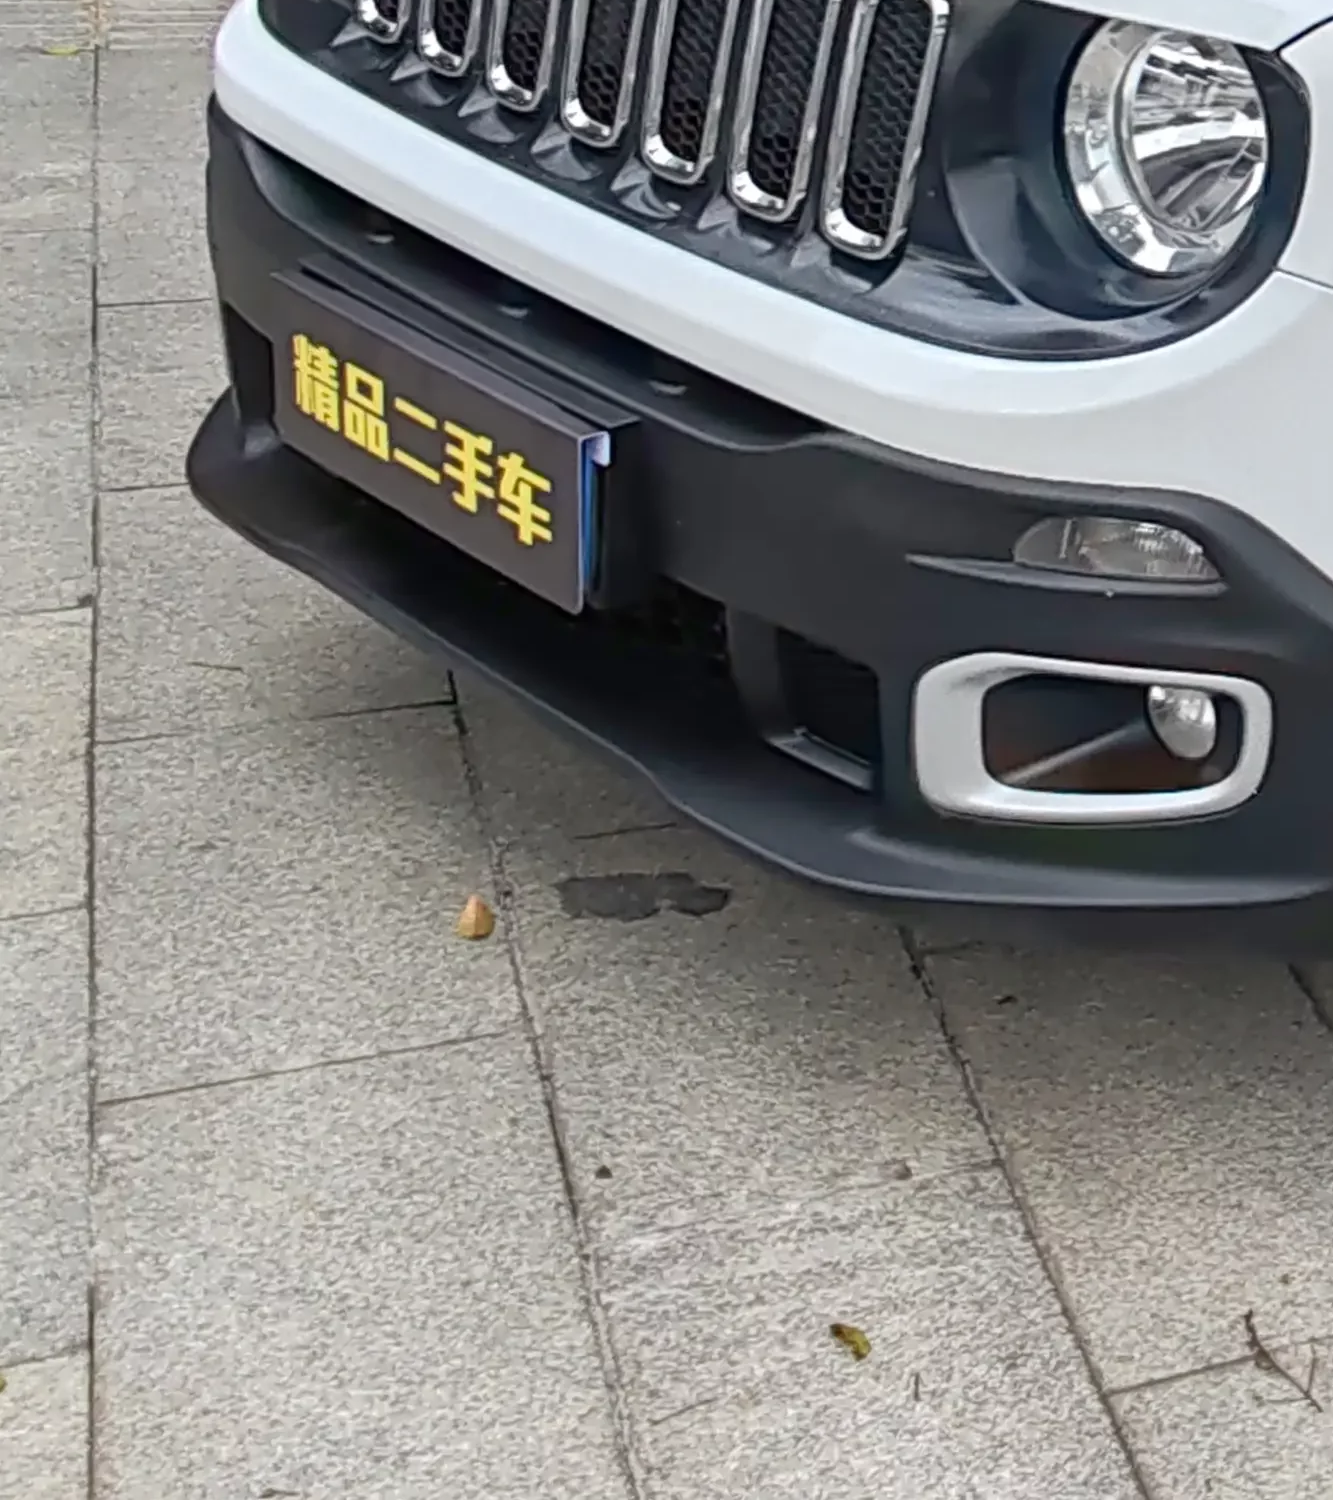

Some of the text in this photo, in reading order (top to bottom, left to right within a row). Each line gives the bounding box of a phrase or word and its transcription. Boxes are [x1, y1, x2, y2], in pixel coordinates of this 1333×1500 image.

[293, 334, 552, 546] 精品二手车
